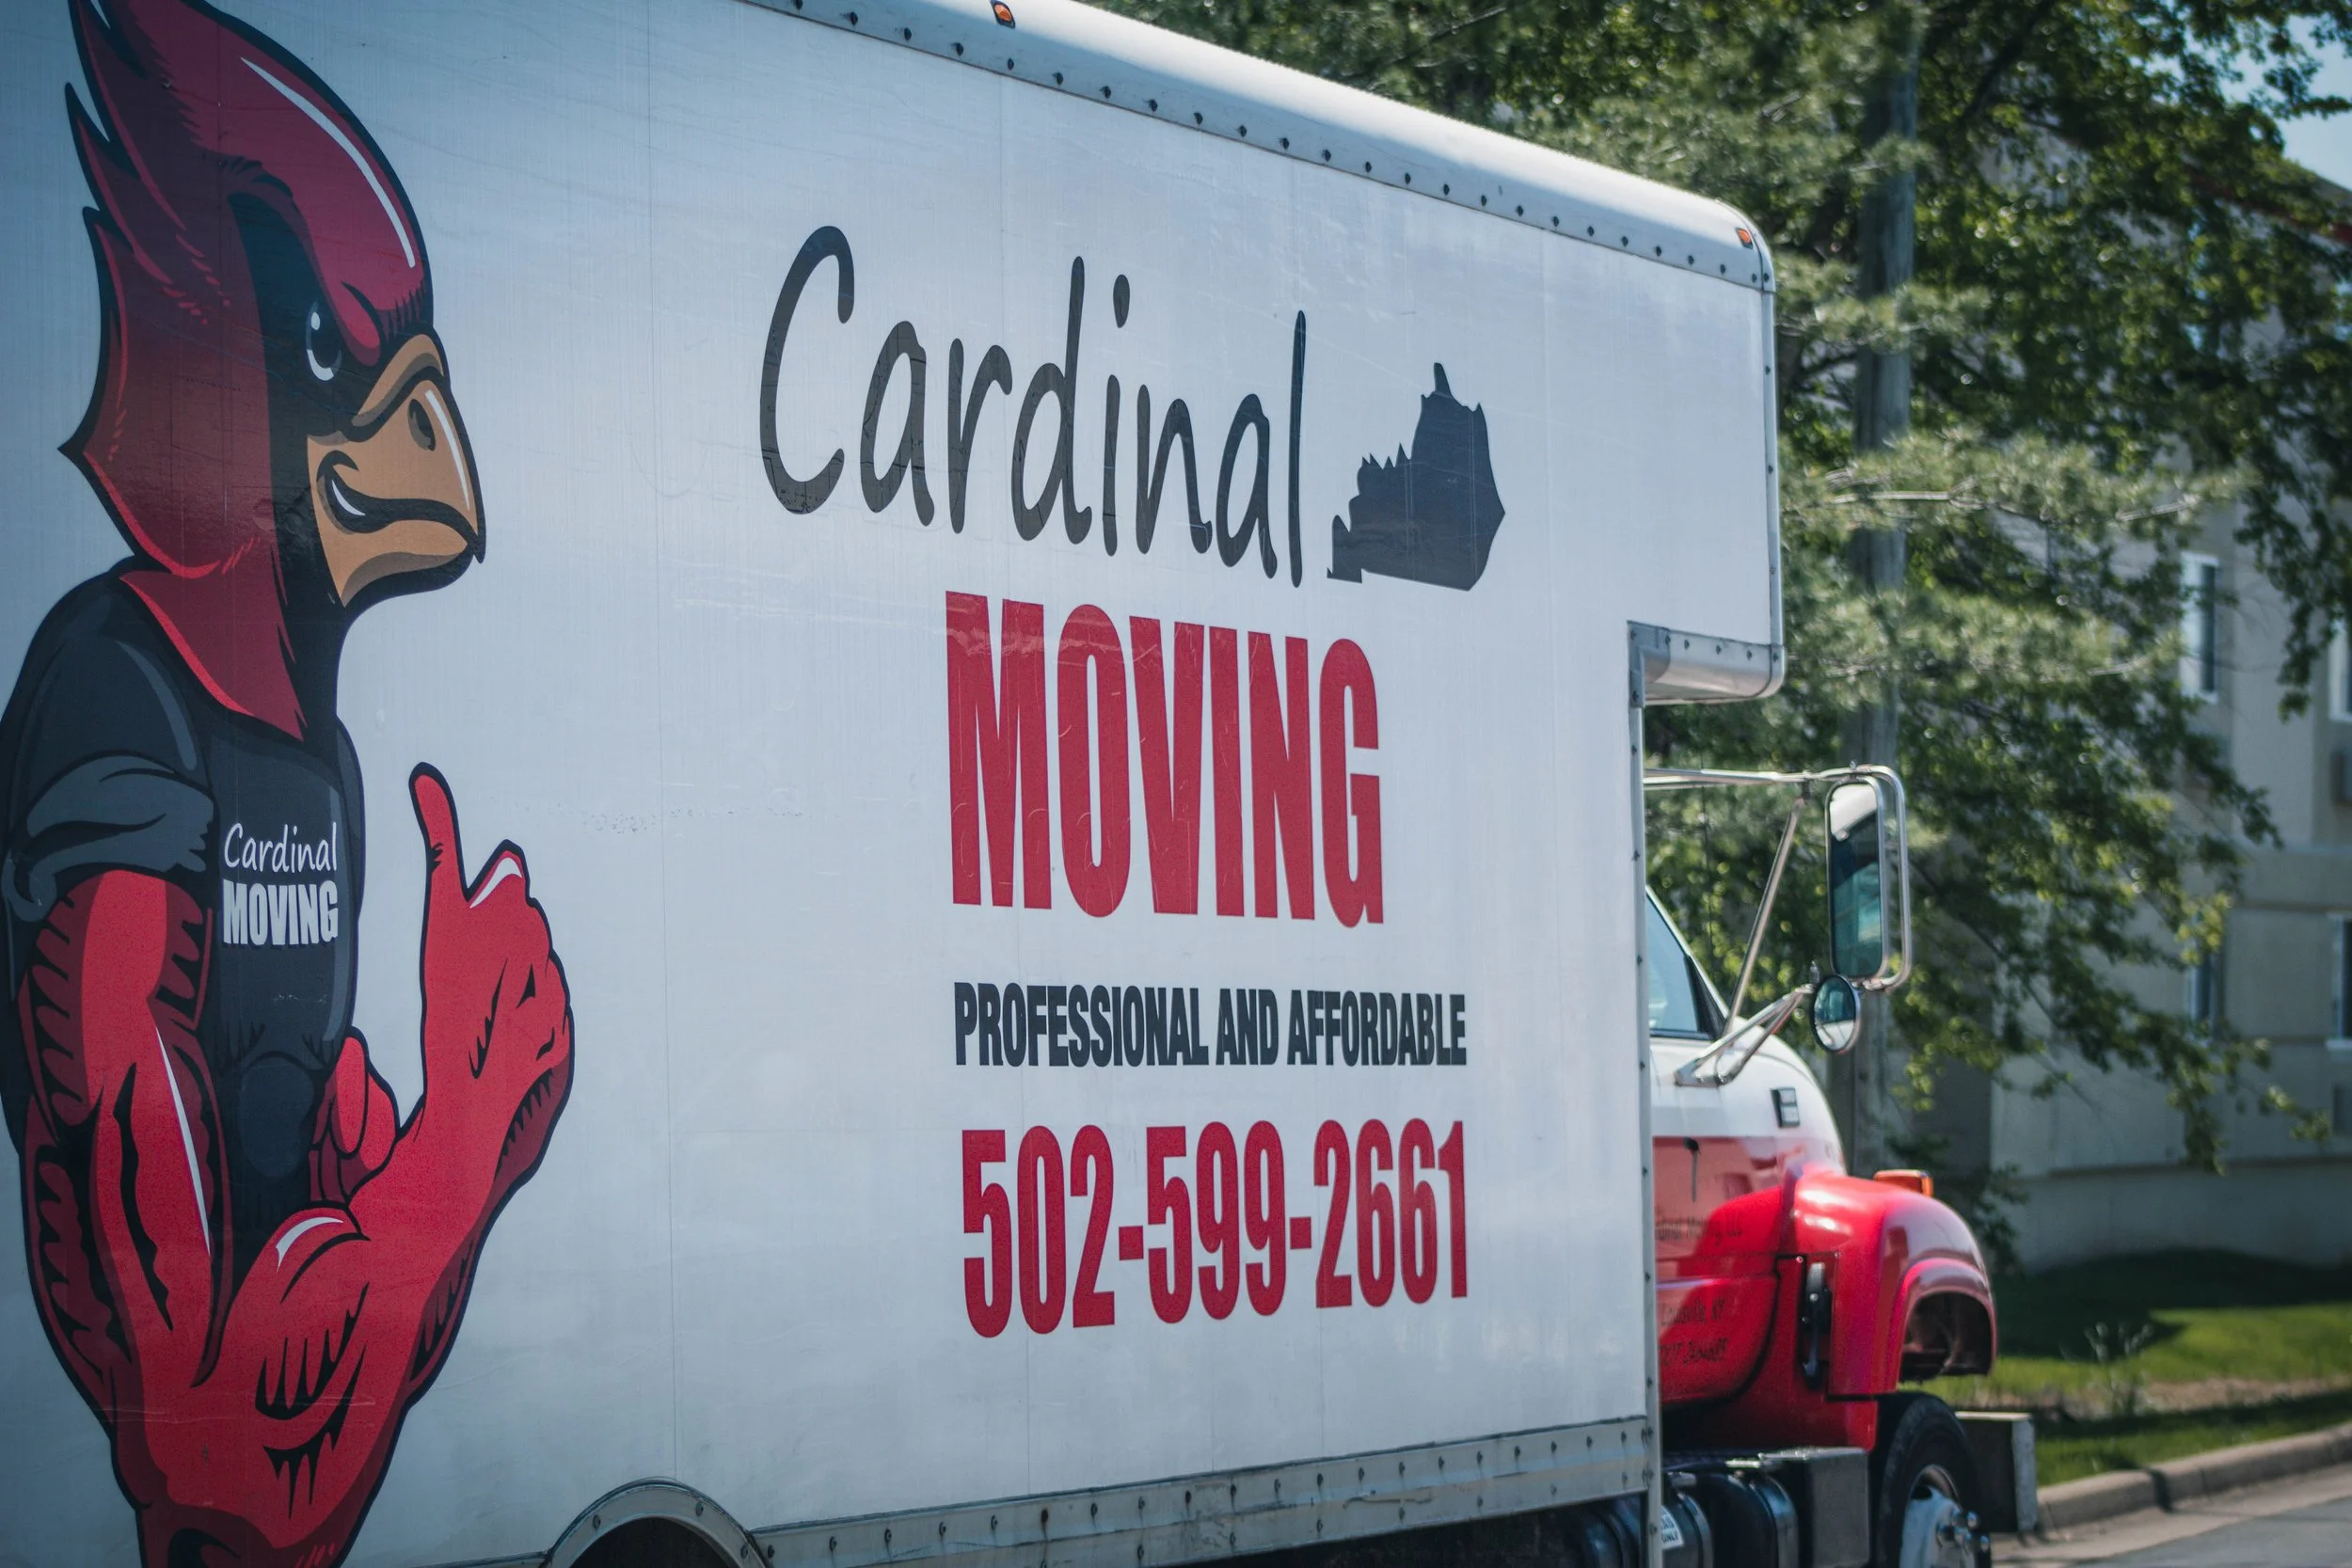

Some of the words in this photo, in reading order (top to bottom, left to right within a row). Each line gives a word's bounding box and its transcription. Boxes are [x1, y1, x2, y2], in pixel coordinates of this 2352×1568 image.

[759, 226, 1306, 588] Cardinal
[946, 591, 1384, 928] MOVING
[223, 821, 338, 873] Cardinal
[223, 879, 339, 945] MOVING
[954, 982, 1209, 1067] PROFESSIONAL
[1216, 988, 1279, 1066] AND
[1287, 990, 1467, 1067] AFFORDABLE
[961, 1118, 1467, 1338] 502-599-2661
